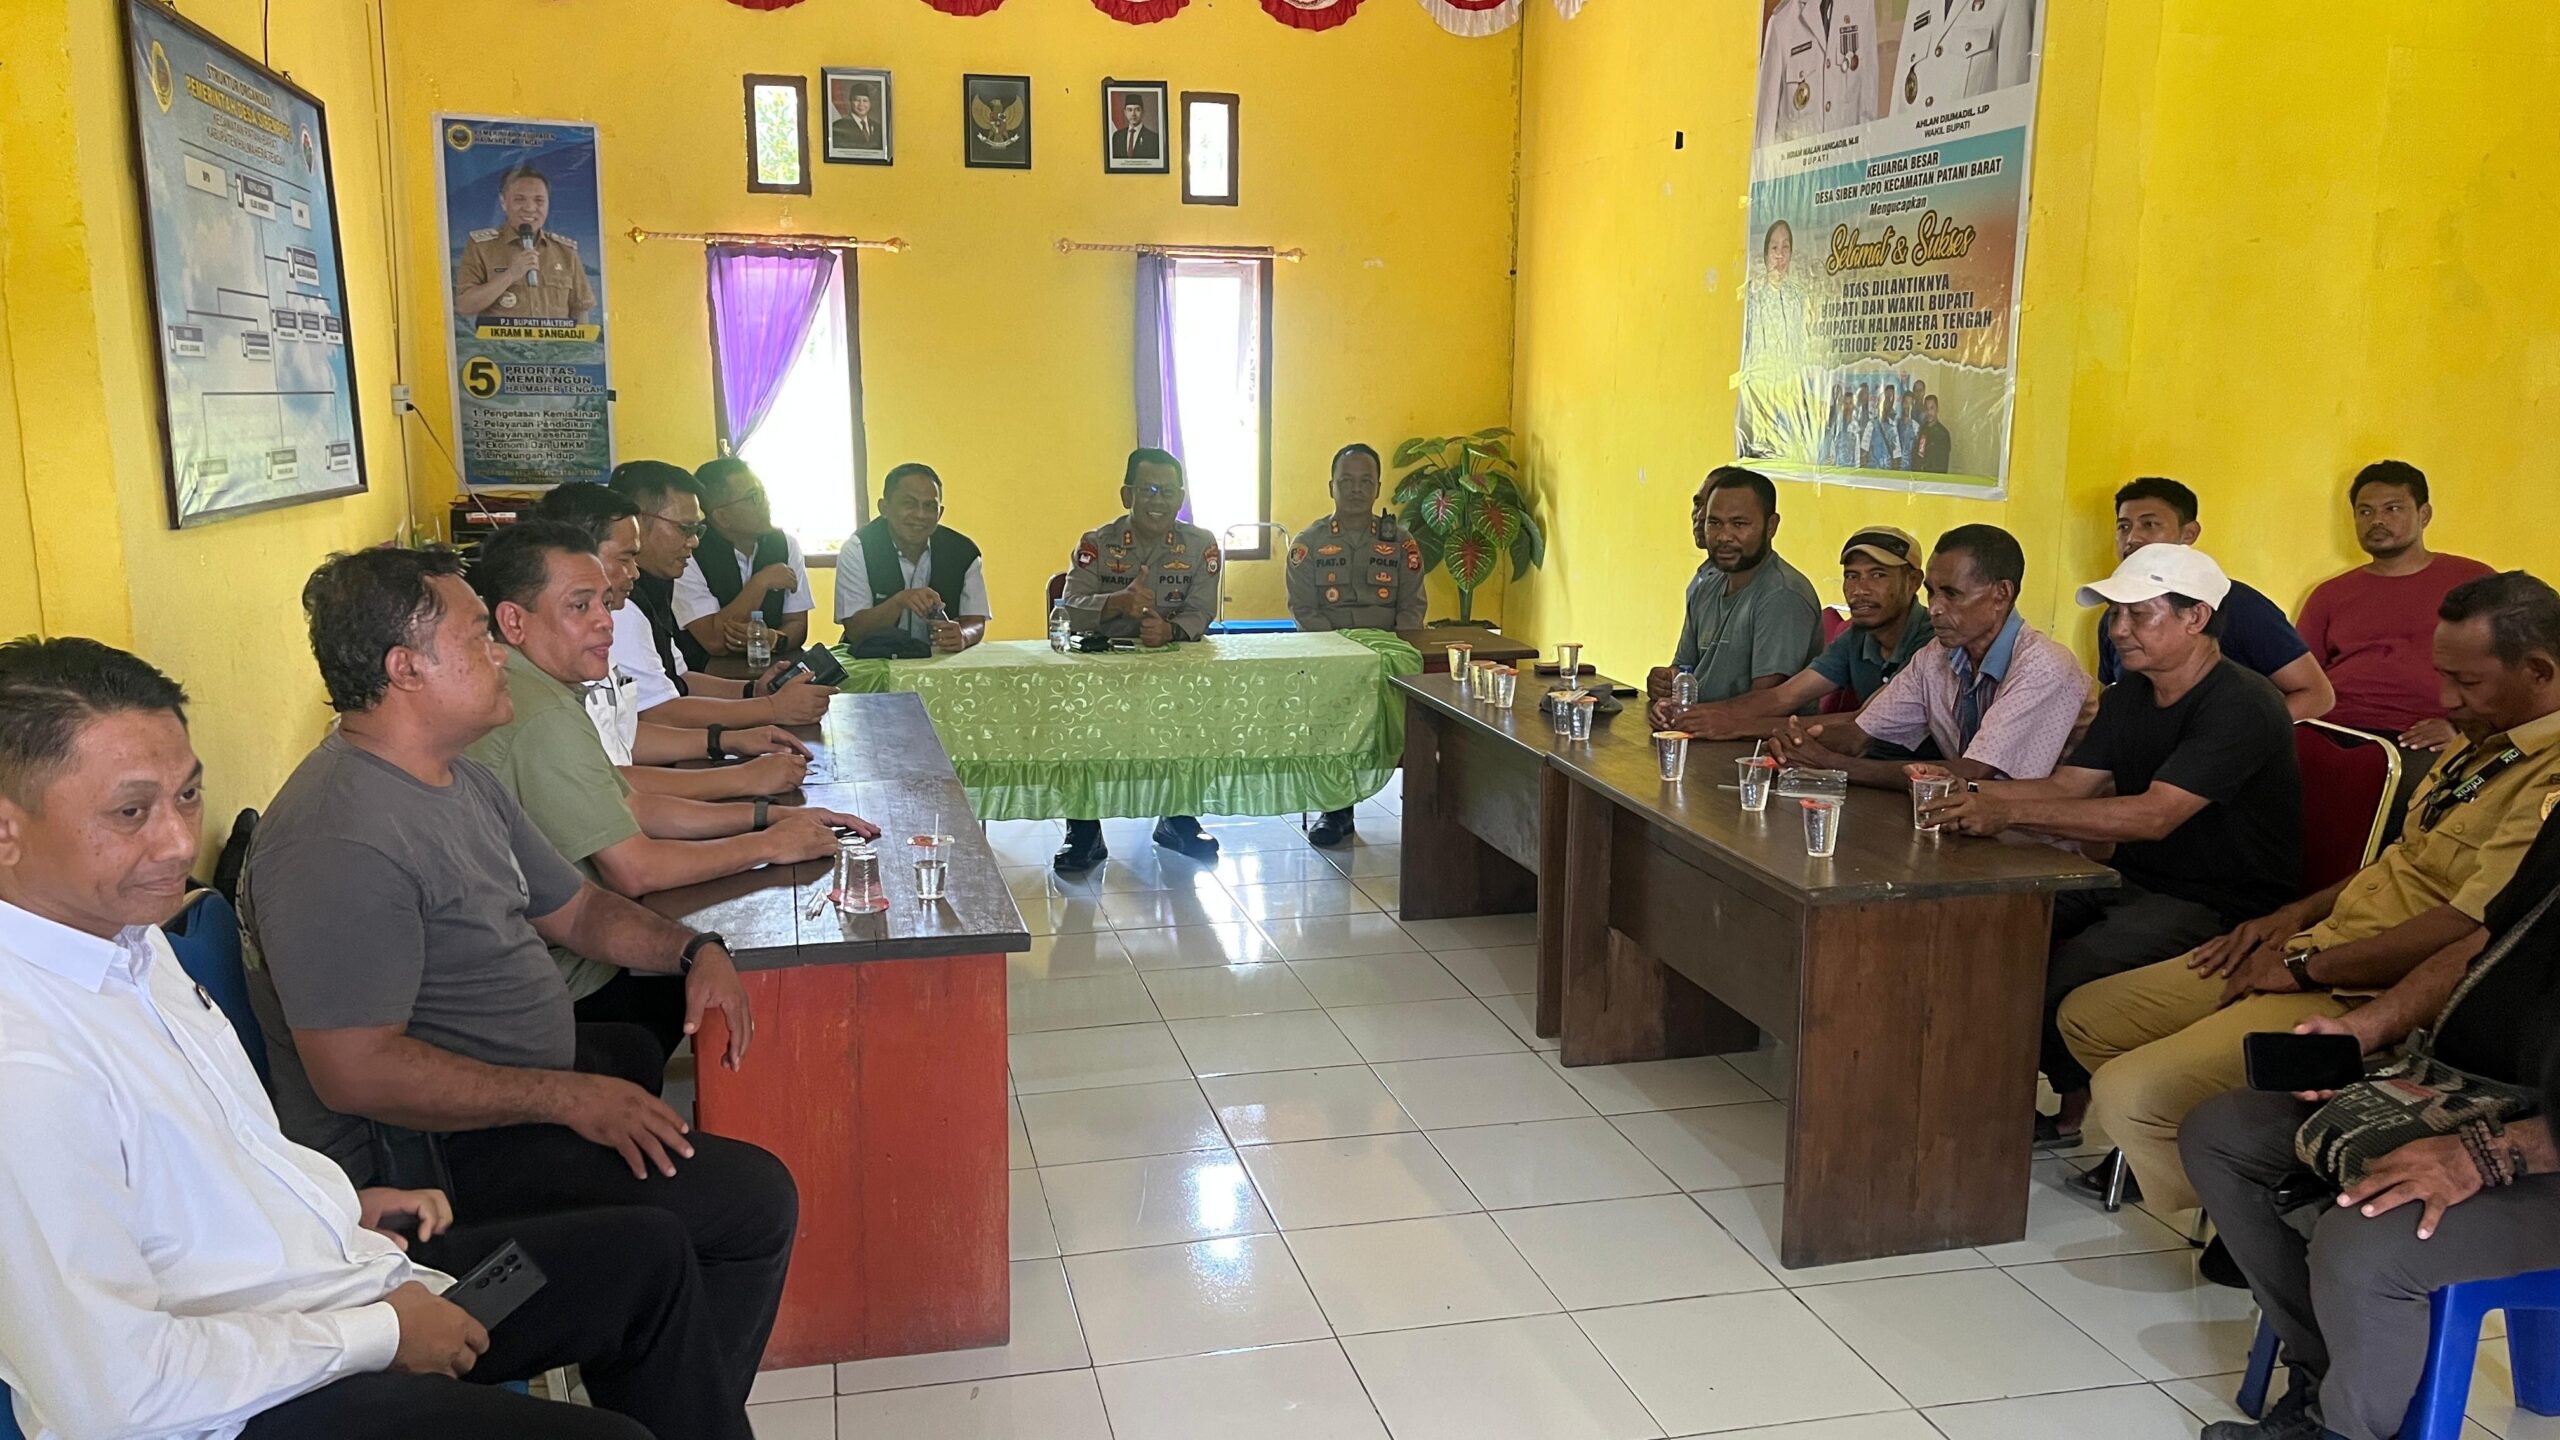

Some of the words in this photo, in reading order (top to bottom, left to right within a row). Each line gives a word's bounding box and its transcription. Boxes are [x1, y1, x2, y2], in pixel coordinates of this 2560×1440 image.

[1916, 116, 1939, 128] AHLAN
[1924, 126, 1944, 138] WAKIL
[1946, 121, 1970, 133] BUPATI
[1802, 154, 1829, 166] BUPATI
[1867, 156, 1909, 178] KELUARGA
[1910, 152, 1939, 169] BESAR
[1815, 191, 1834, 204] DESA
[1836, 186, 1858, 201] SIBEN
[1860, 181, 1881, 196] POPO
[1884, 171, 1934, 192] KECAMATAN
[1937, 165, 1968, 183] PATANI
[1970, 158, 2002, 177] BARAT
[1869, 196, 1927, 216] Mengucapkan
[1826, 223, 1895, 275] Selamat
[1892, 236, 1908, 265] &
[1912, 210, 1976, 266] Sukses
[1843, 281, 1869, 298] ATAS
[1872, 274, 1950, 296] DILANTIKNYA
[1821, 301, 1858, 318] BUPATI
[1862, 299, 1884, 315] DAN
[1887, 296, 1924, 313] WAKIL
[1929, 292, 1974, 310] BUPATI
[513, 319, 540, 327] BUPATI
[541, 319, 574, 327] HALTENG
[1868, 315, 1938, 333] HALMAHERA
[1942, 311, 1992, 329] TENGAH
[490, 328, 520, 337] IKRAM
[524, 329, 536, 338] M.
[538, 329, 585, 339] SANGADJI
[1832, 336, 1877, 353] PERIODE
[1883, 335, 1913, 351] 2025
[1925, 333, 1958, 349] 2030
[505, 366, 575, 375] PRIORITAS
[469, 361, 496, 396] 5
[505, 375, 591, 384] MEMBANGUN
[563, 385, 603, 393] TENGAH
[543, 409, 600, 418] Kemiskinan
[484, 420, 533, 429] Pelayanan
[537, 420, 591, 428] Pendidikan
[485, 430, 536, 439] Pelayanan
[486, 441, 527, 449] Ekonomi
[531, 441, 550, 449] Dan
[553, 441, 585, 449] UMKM
[486, 451, 542, 460] Lingkungan
[546, 452, 575, 460] Hidup
[1369, 557, 1398, 568] POLRI
[1159, 575, 1192, 584] POLRI
